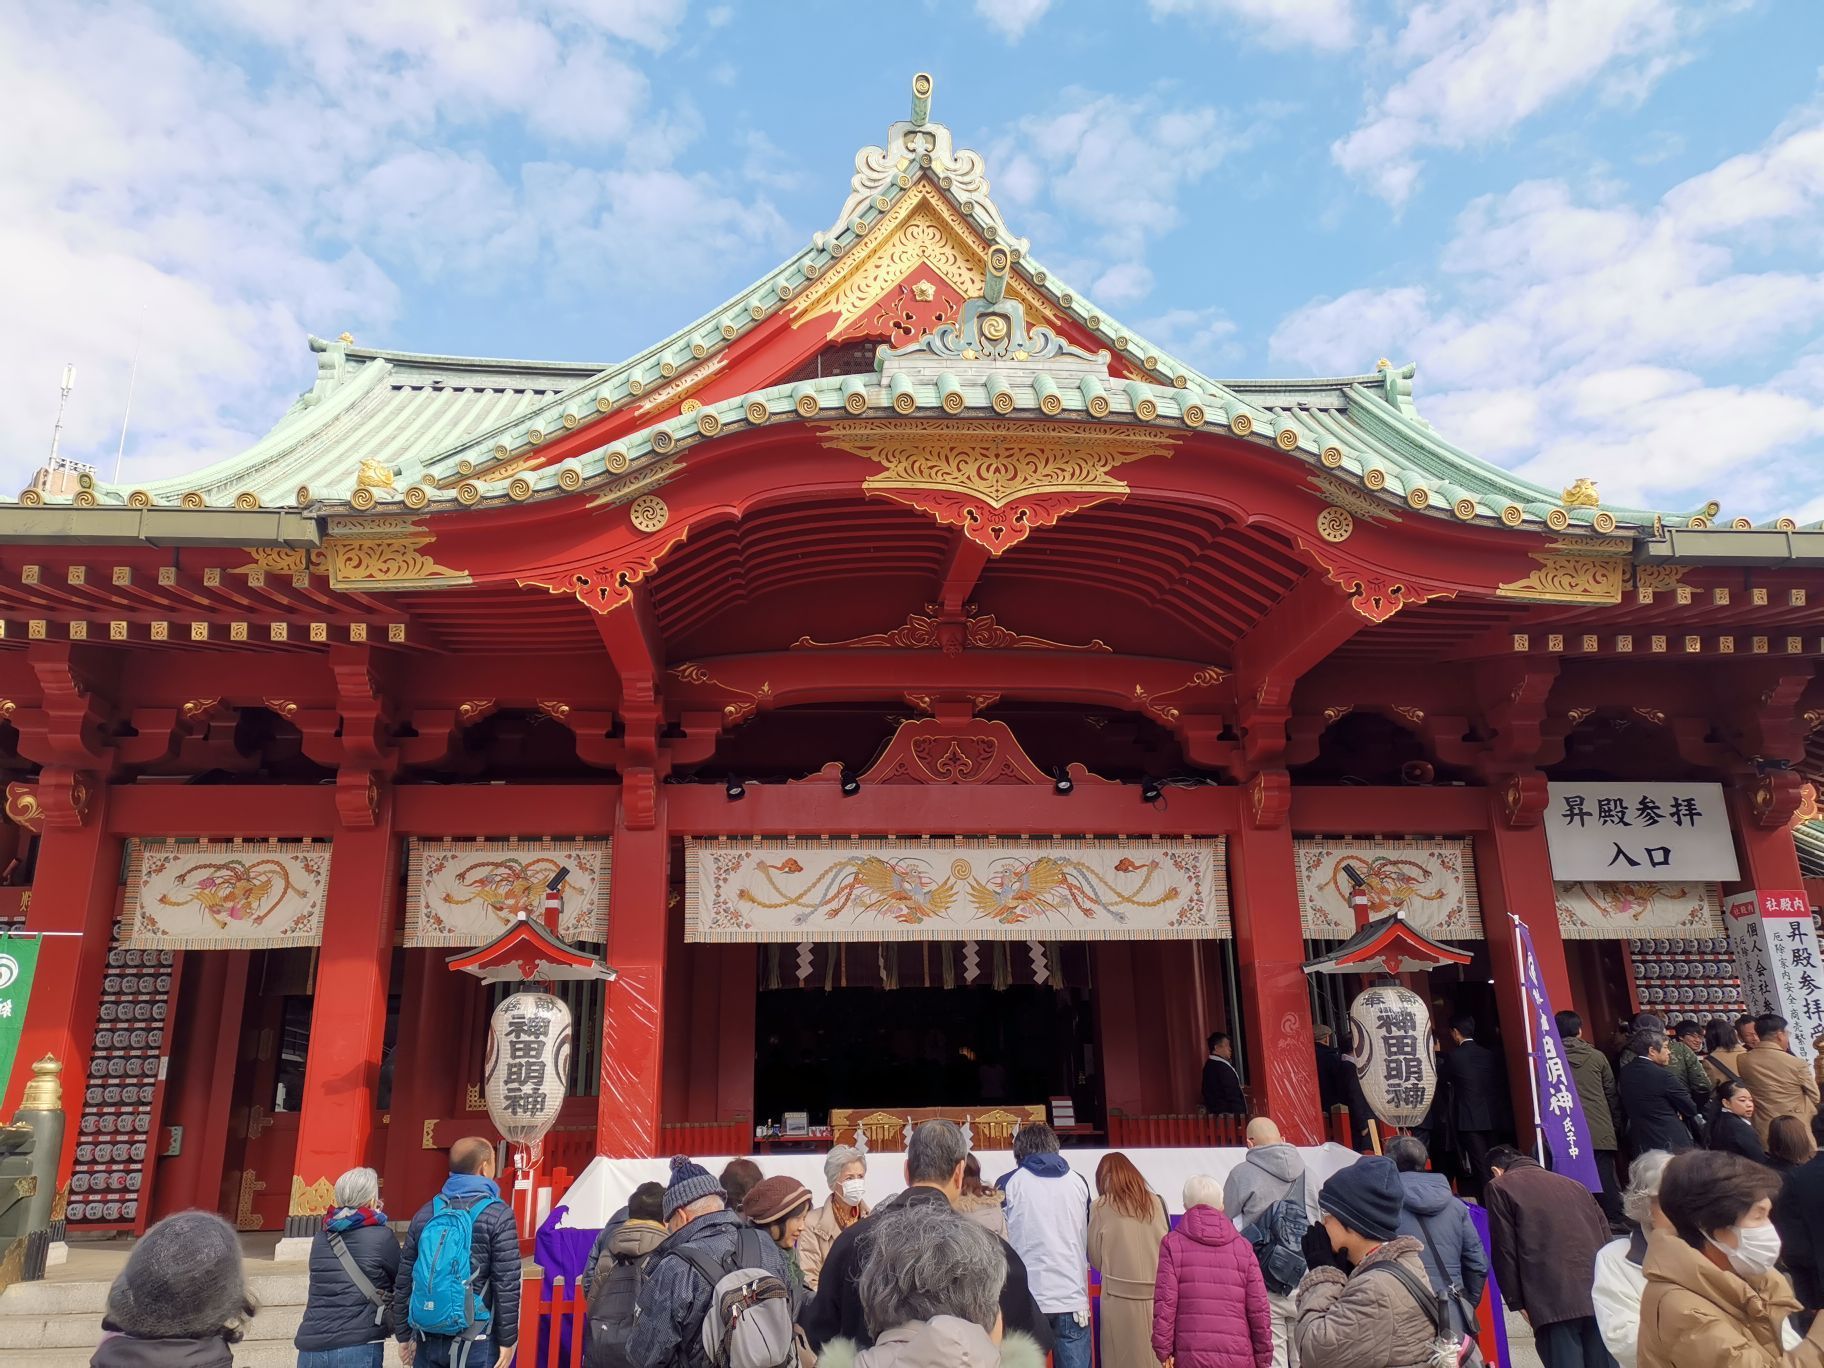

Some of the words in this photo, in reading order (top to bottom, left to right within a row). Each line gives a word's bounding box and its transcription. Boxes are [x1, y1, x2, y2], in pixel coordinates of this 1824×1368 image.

[1561, 795, 1703, 828] 昇殿参拝
[1607, 842, 1672, 868] 入口
[1765, 897, 1805, 912] 社殿内
[503, 1013, 552, 1118] 神田明神
[1376, 1006, 1426, 1109] 神田明神
